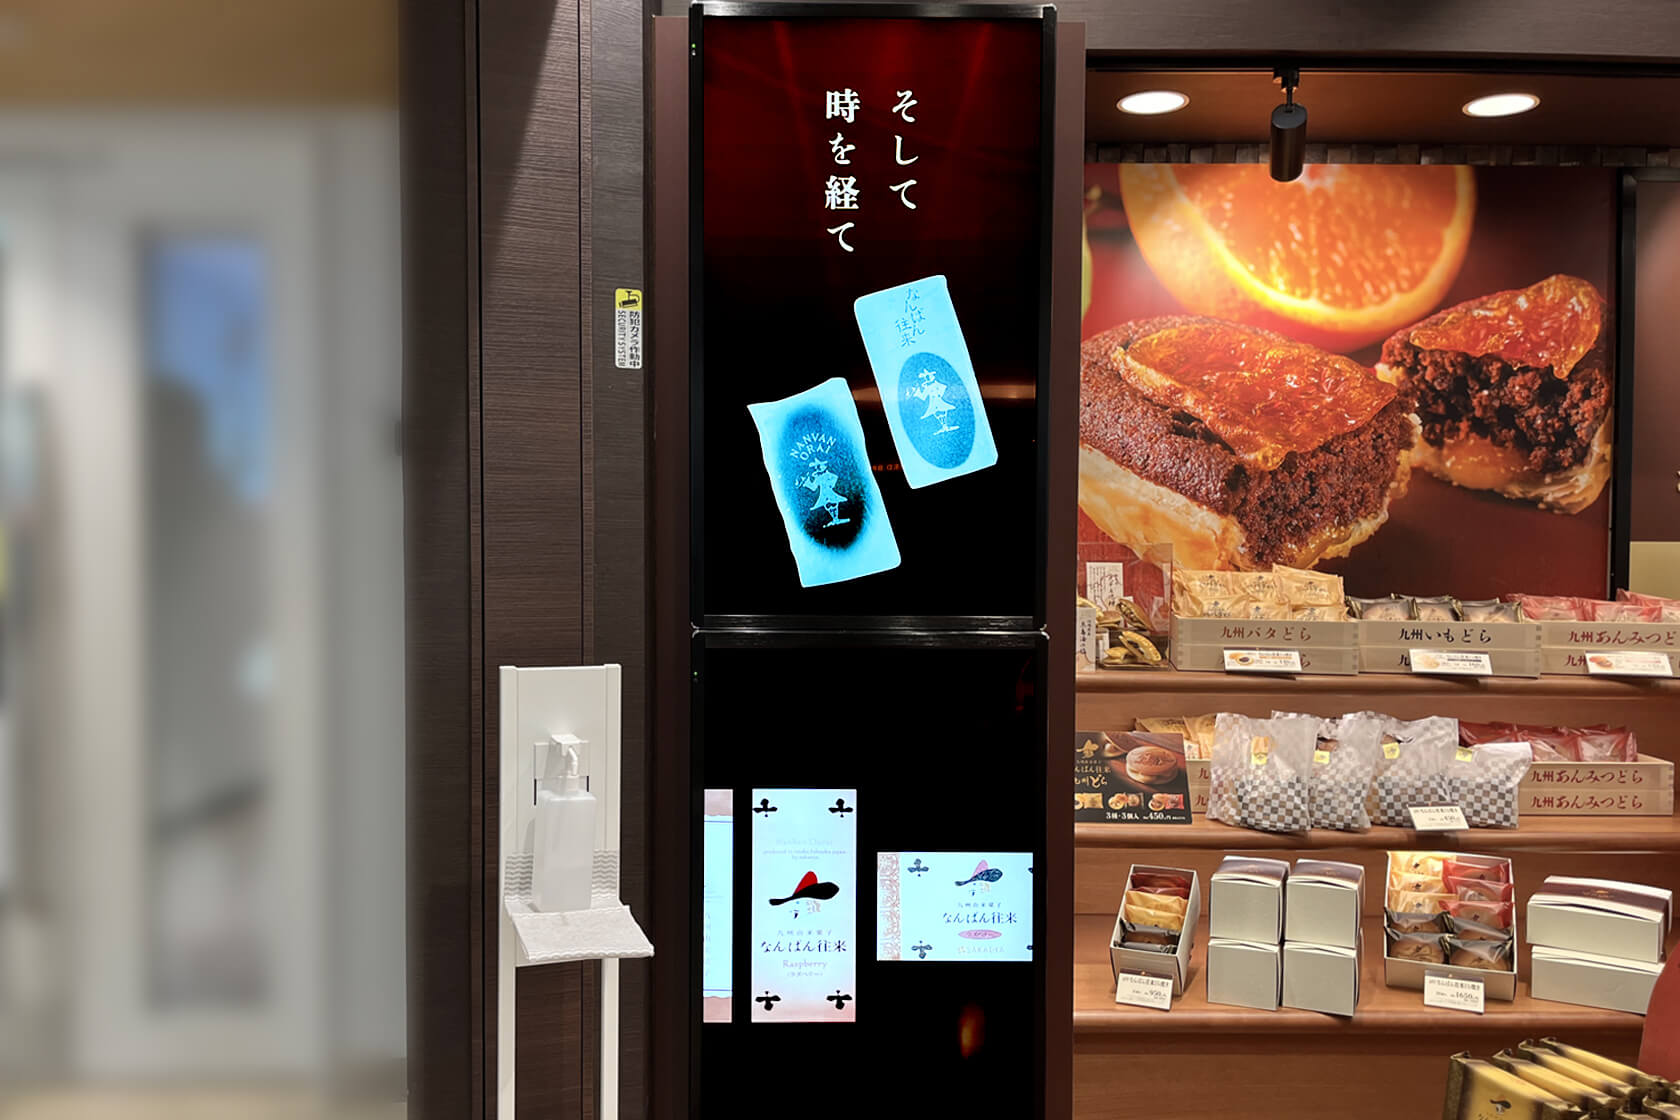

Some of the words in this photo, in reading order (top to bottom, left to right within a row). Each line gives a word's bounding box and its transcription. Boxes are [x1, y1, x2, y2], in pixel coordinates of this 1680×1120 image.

[889, 90, 919, 210] そして
[824, 88, 860, 252] 時を経て
[1222, 626, 1311, 641] 九州バタどら
[1398, 627, 1492, 643] 九州いもどら
[1531, 770, 1643, 784] 九州あんみつどら
[1530, 795, 1643, 810] 九州あんみつどら
[760, 939, 847, 953] なんばん往来
